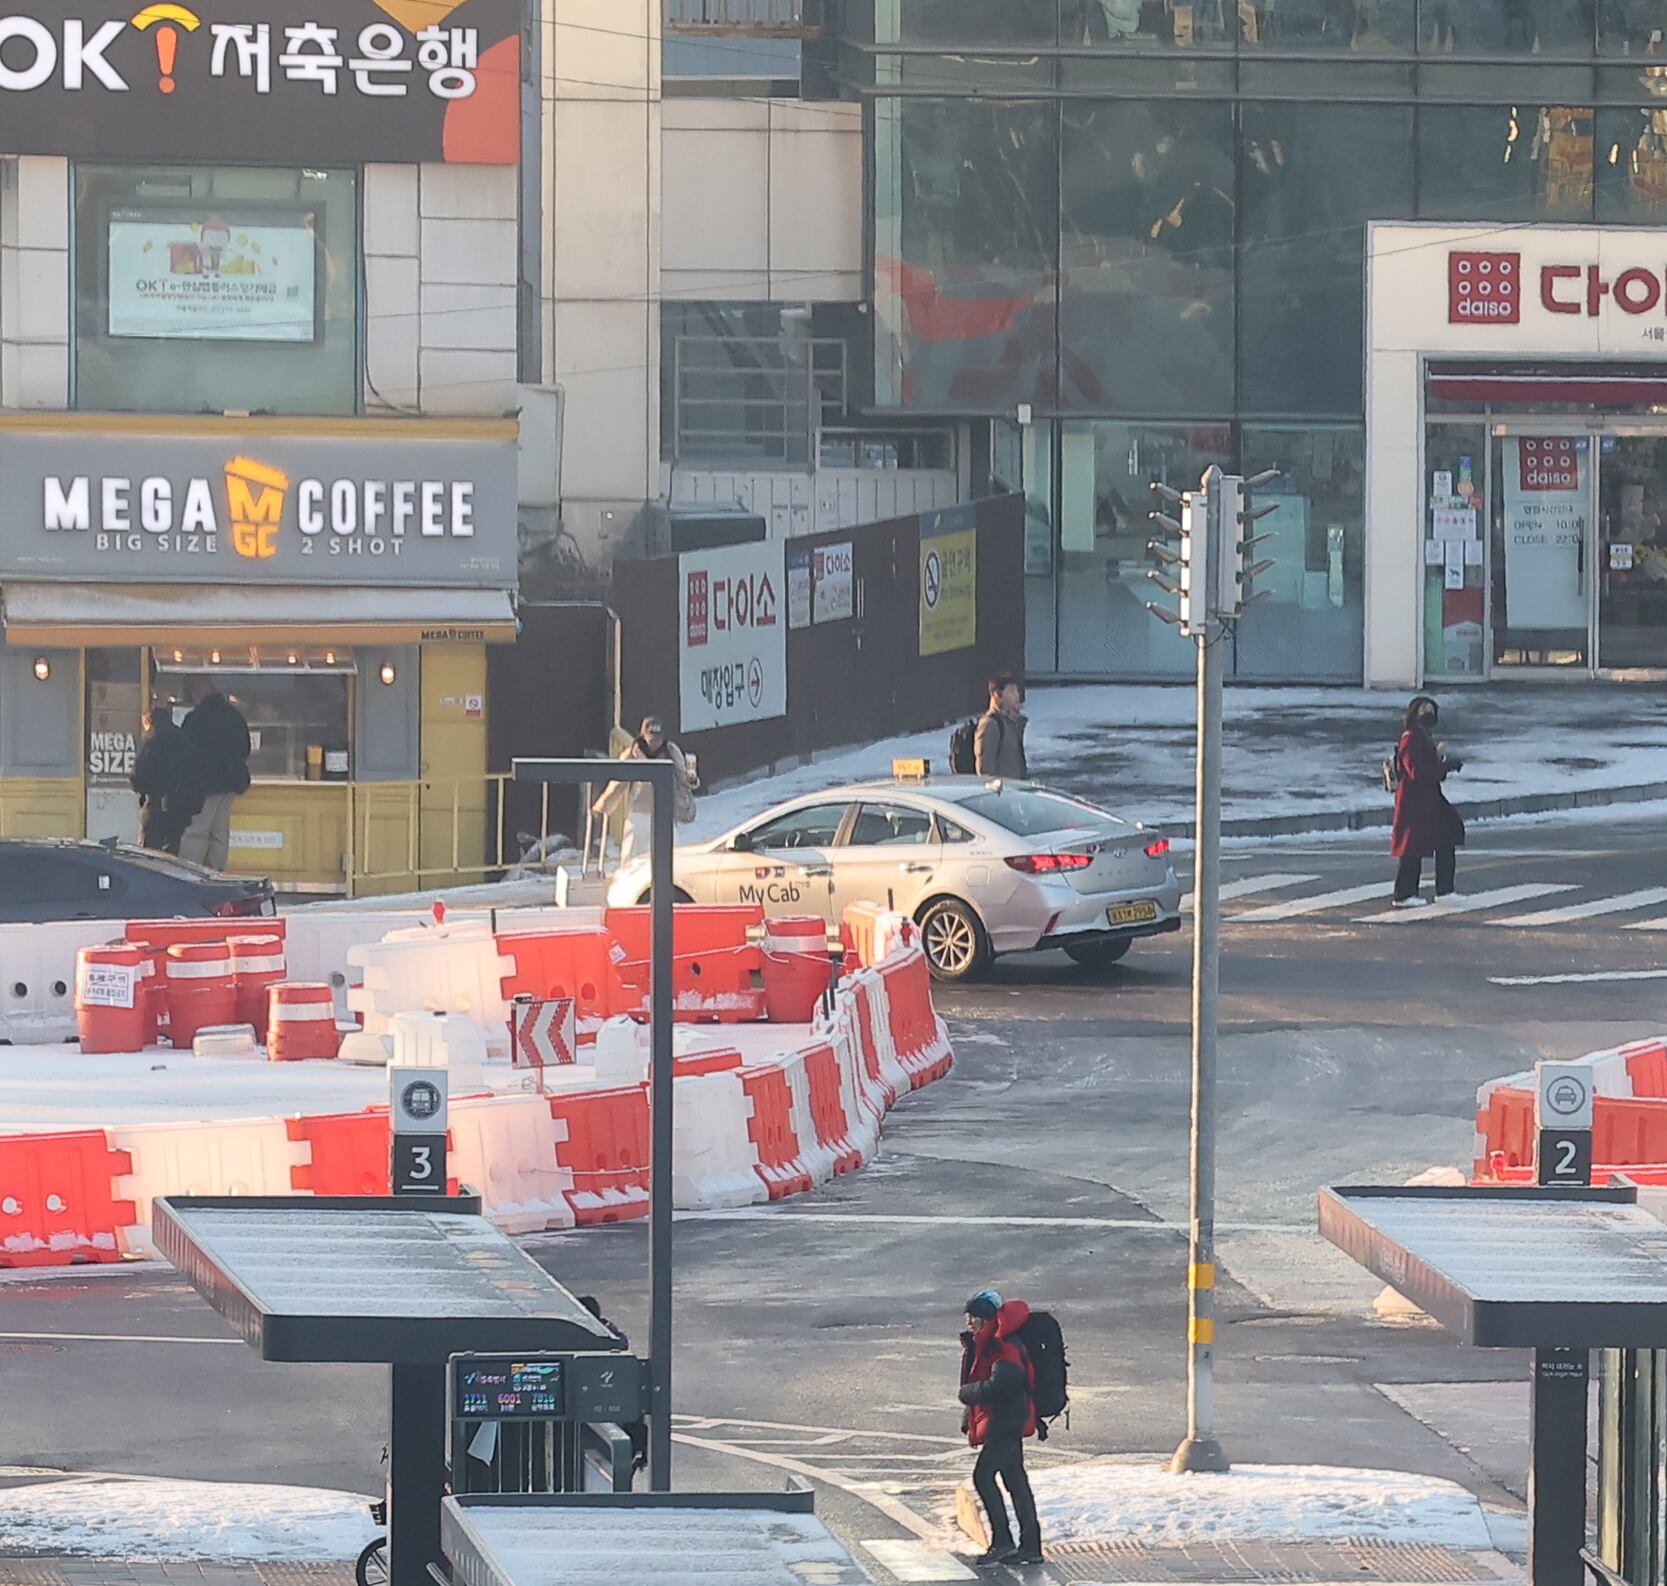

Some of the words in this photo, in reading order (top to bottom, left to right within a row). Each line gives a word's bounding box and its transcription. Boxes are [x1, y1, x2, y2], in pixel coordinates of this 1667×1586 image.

[210, 22, 479, 99] 저축은행
[1457, 297, 1512, 317] daiso
[1526, 469, 1572, 486] daiso
[43, 475, 219, 533] MEGA
[298, 479, 476, 538] COFFEE
[1513, 518, 1543, 530] OPEN
[96, 533, 143, 552] BIG
[157, 534, 219, 554] SIZE
[301, 537, 314, 555] 2
[328, 537, 404, 557] SHOT
[825, 551, 851, 576] 다이소
[712, 571, 777, 632] 다이소
[701, 661, 746, 709] 매장입구
[90, 731, 136, 752] MEGA
[89, 751, 137, 774] SIZE
[410, 1146, 432, 1179] 3
[1554, 1139, 1577, 1174] 2
[497, 1393, 522, 1405] 6001
